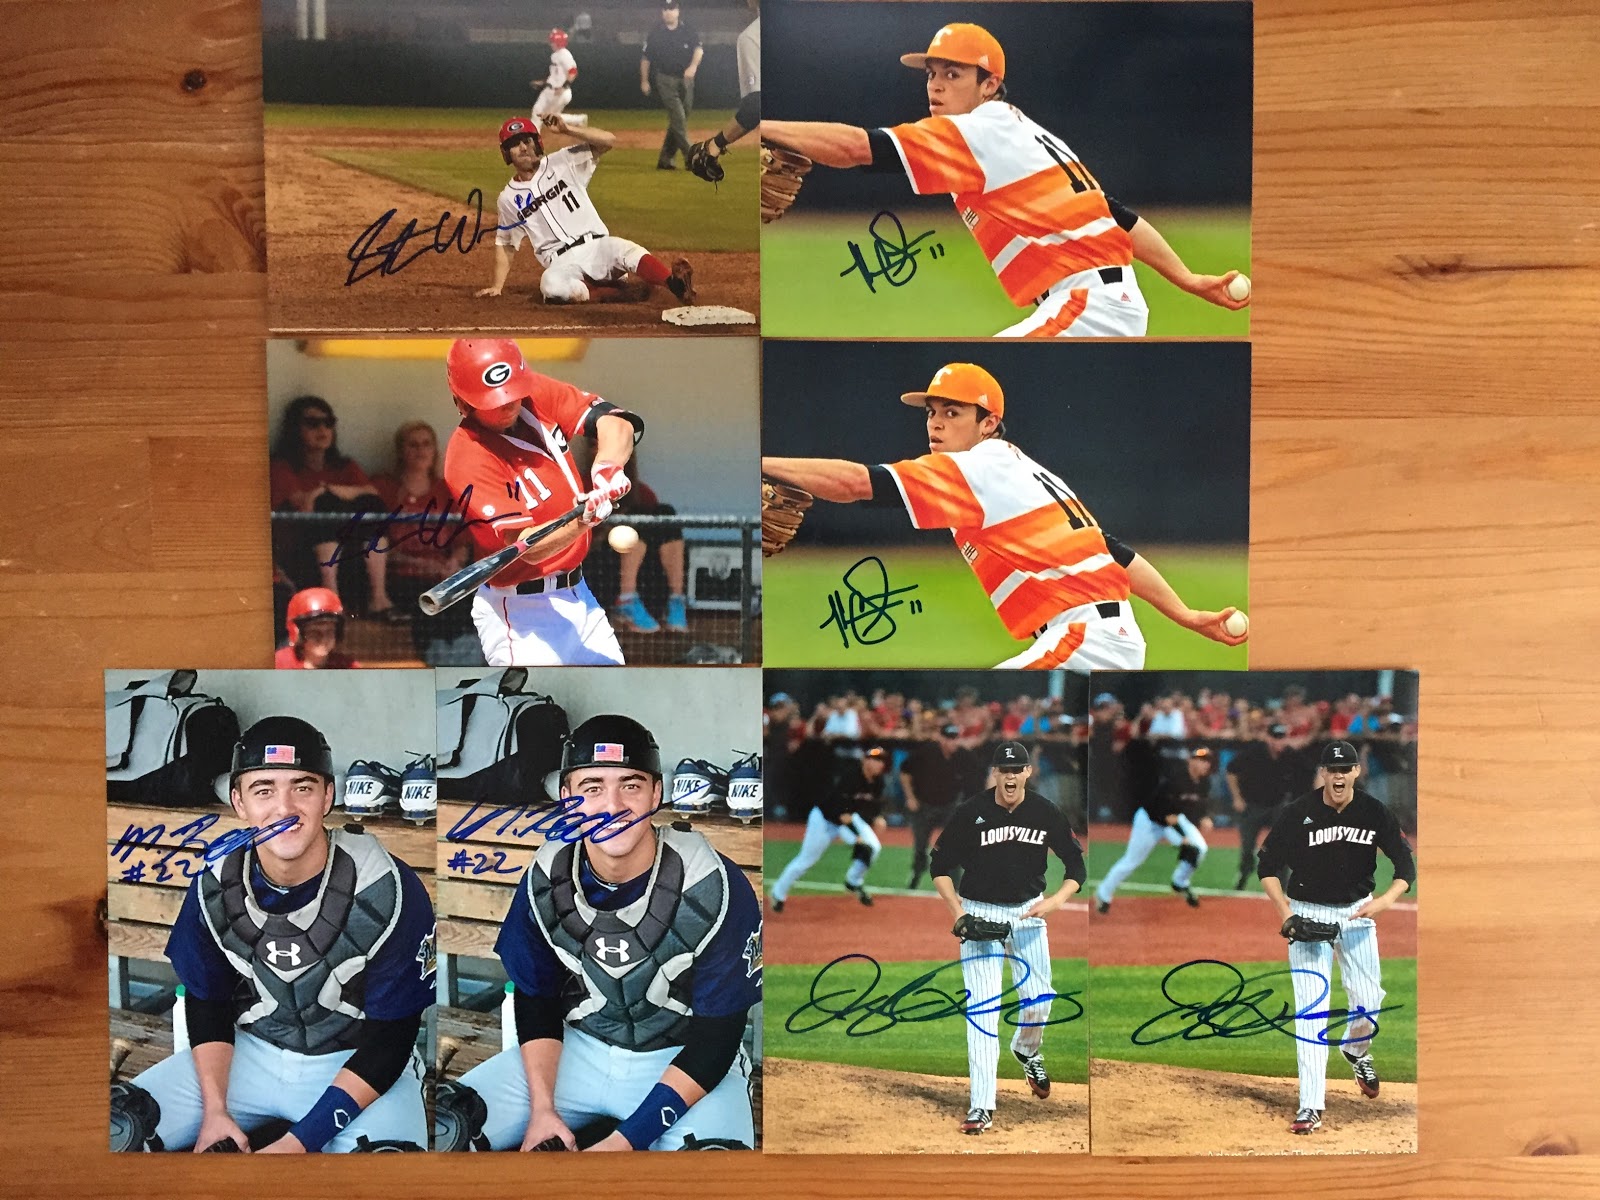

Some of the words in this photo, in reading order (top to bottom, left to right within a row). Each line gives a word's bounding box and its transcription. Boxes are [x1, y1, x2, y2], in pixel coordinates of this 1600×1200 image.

[1034, 134, 1097, 194] 11
[507, 179, 568, 220] GEORGIA
[562, 190, 580, 213] 11
[484, 363, 511, 387] G
[515, 467, 553, 510] 11
[1033, 472, 1094, 530] 11
[347, 781, 374, 795] NIKE
[404, 785, 432, 800] NIKE
[674, 779, 701, 793] NIKE
[731, 784, 759, 798] NIKE
[980, 825, 1047, 846] LOUISVILLE
[1308, 825, 1376, 847] LOUISVILLE
[447, 848, 523, 875] #22
